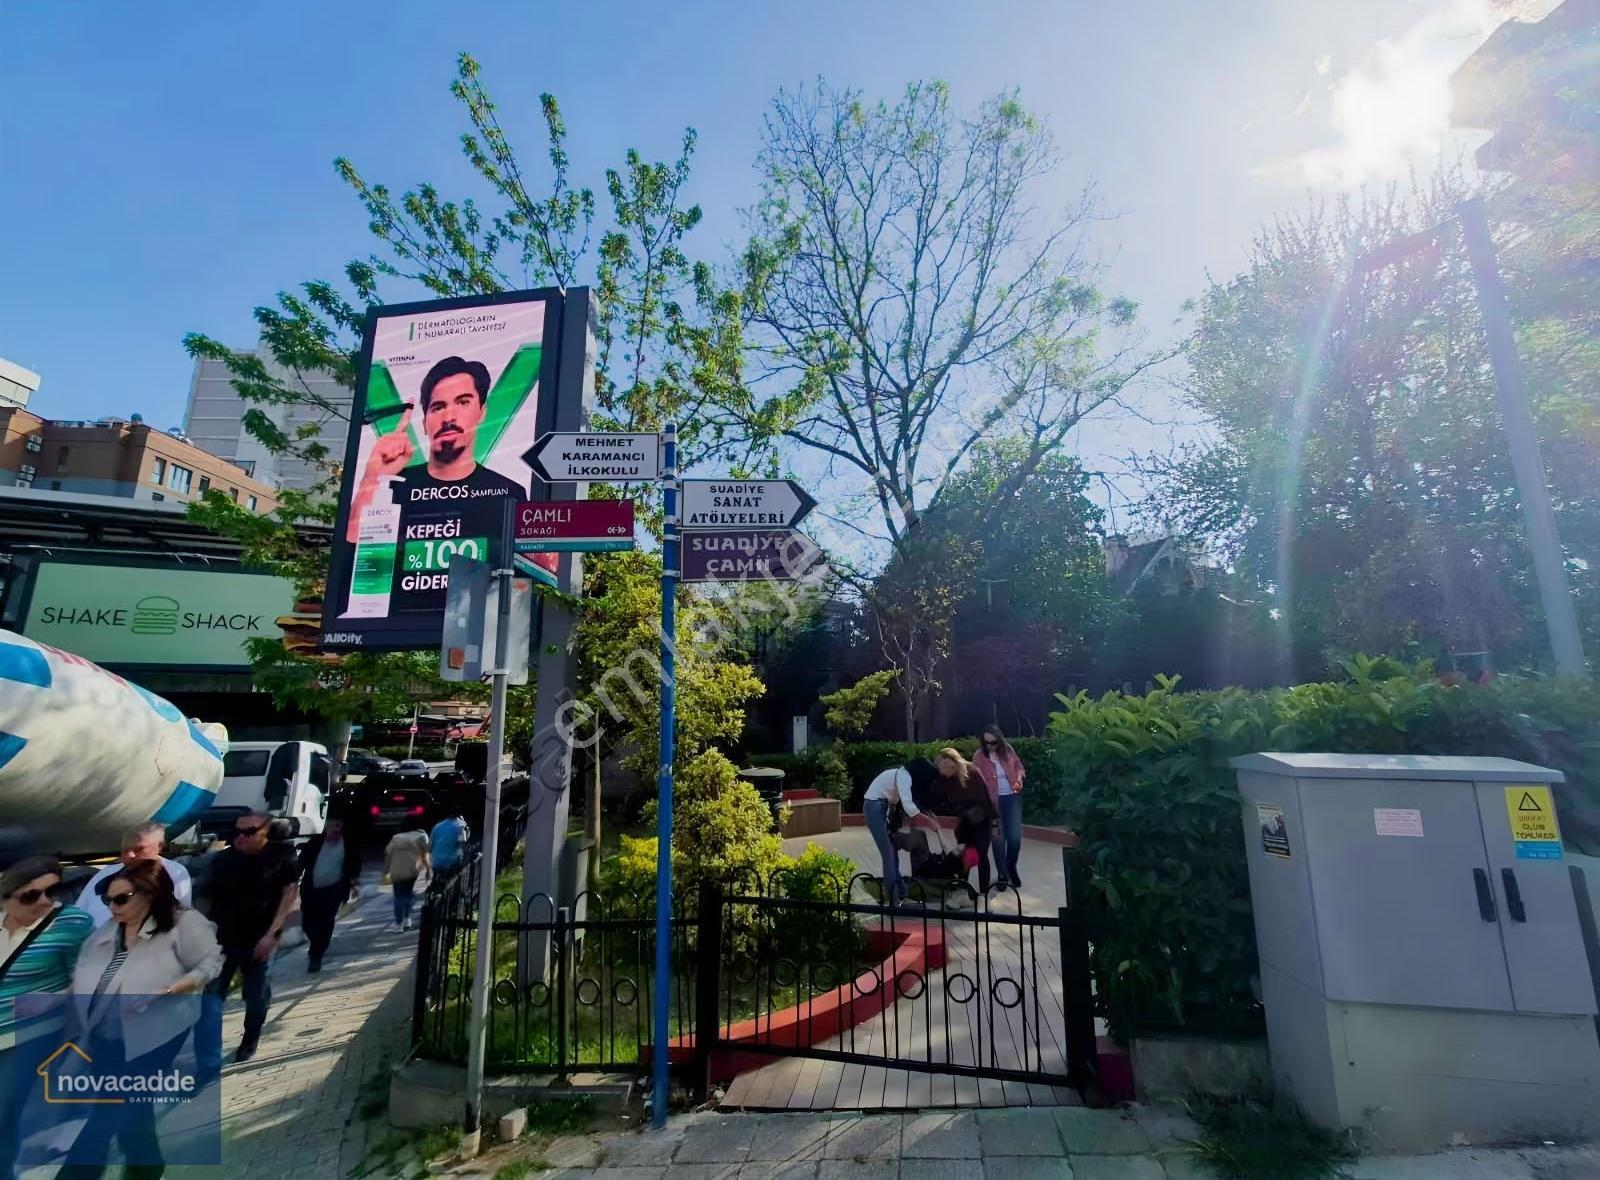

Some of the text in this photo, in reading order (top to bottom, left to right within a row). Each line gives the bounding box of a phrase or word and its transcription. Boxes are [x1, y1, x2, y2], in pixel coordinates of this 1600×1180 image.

[575, 438, 634, 447] MEHMET
[562, 452, 645, 461] KARAMANCI
[568, 464, 639, 475] İLKOKULU
[410, 485, 468, 501] DERCOS
[710, 483, 764, 494] SUADİYE
[713, 496, 762, 507] SANAT
[522, 508, 571, 526] ÇAMLI
[689, 510, 785, 524] ATÖLYELERİ
[406, 519, 461, 539] KEPEĞİ
[520, 527, 556, 535] SOKAĞI
[692, 533, 785, 551] SUADİYE
[41, 606, 264, 631] SHAKE SHACK
